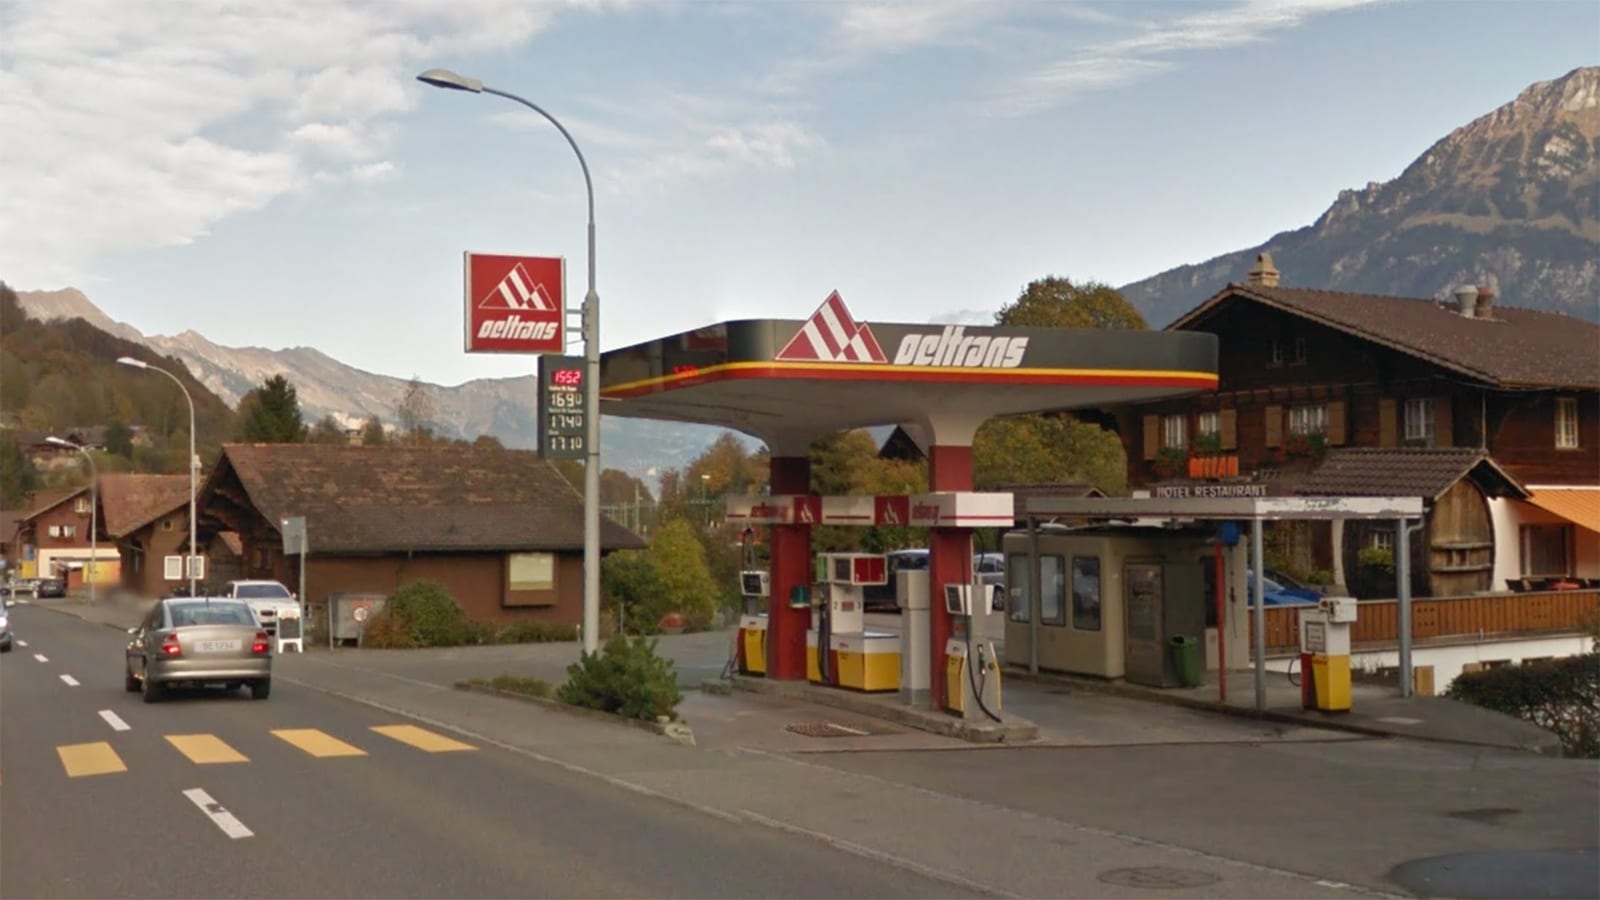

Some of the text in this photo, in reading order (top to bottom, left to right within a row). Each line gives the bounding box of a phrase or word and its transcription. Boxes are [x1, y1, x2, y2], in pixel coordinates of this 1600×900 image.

[477, 315, 558, 339] oeltrans
[894, 325, 1029, 367] oeltrans
[551, 393, 582, 407] 1690
[551, 415, 582, 428] 1740
[551, 437, 582, 450] 1710
[1156, 485, 1267, 498] HOTEL RESTAURANT
